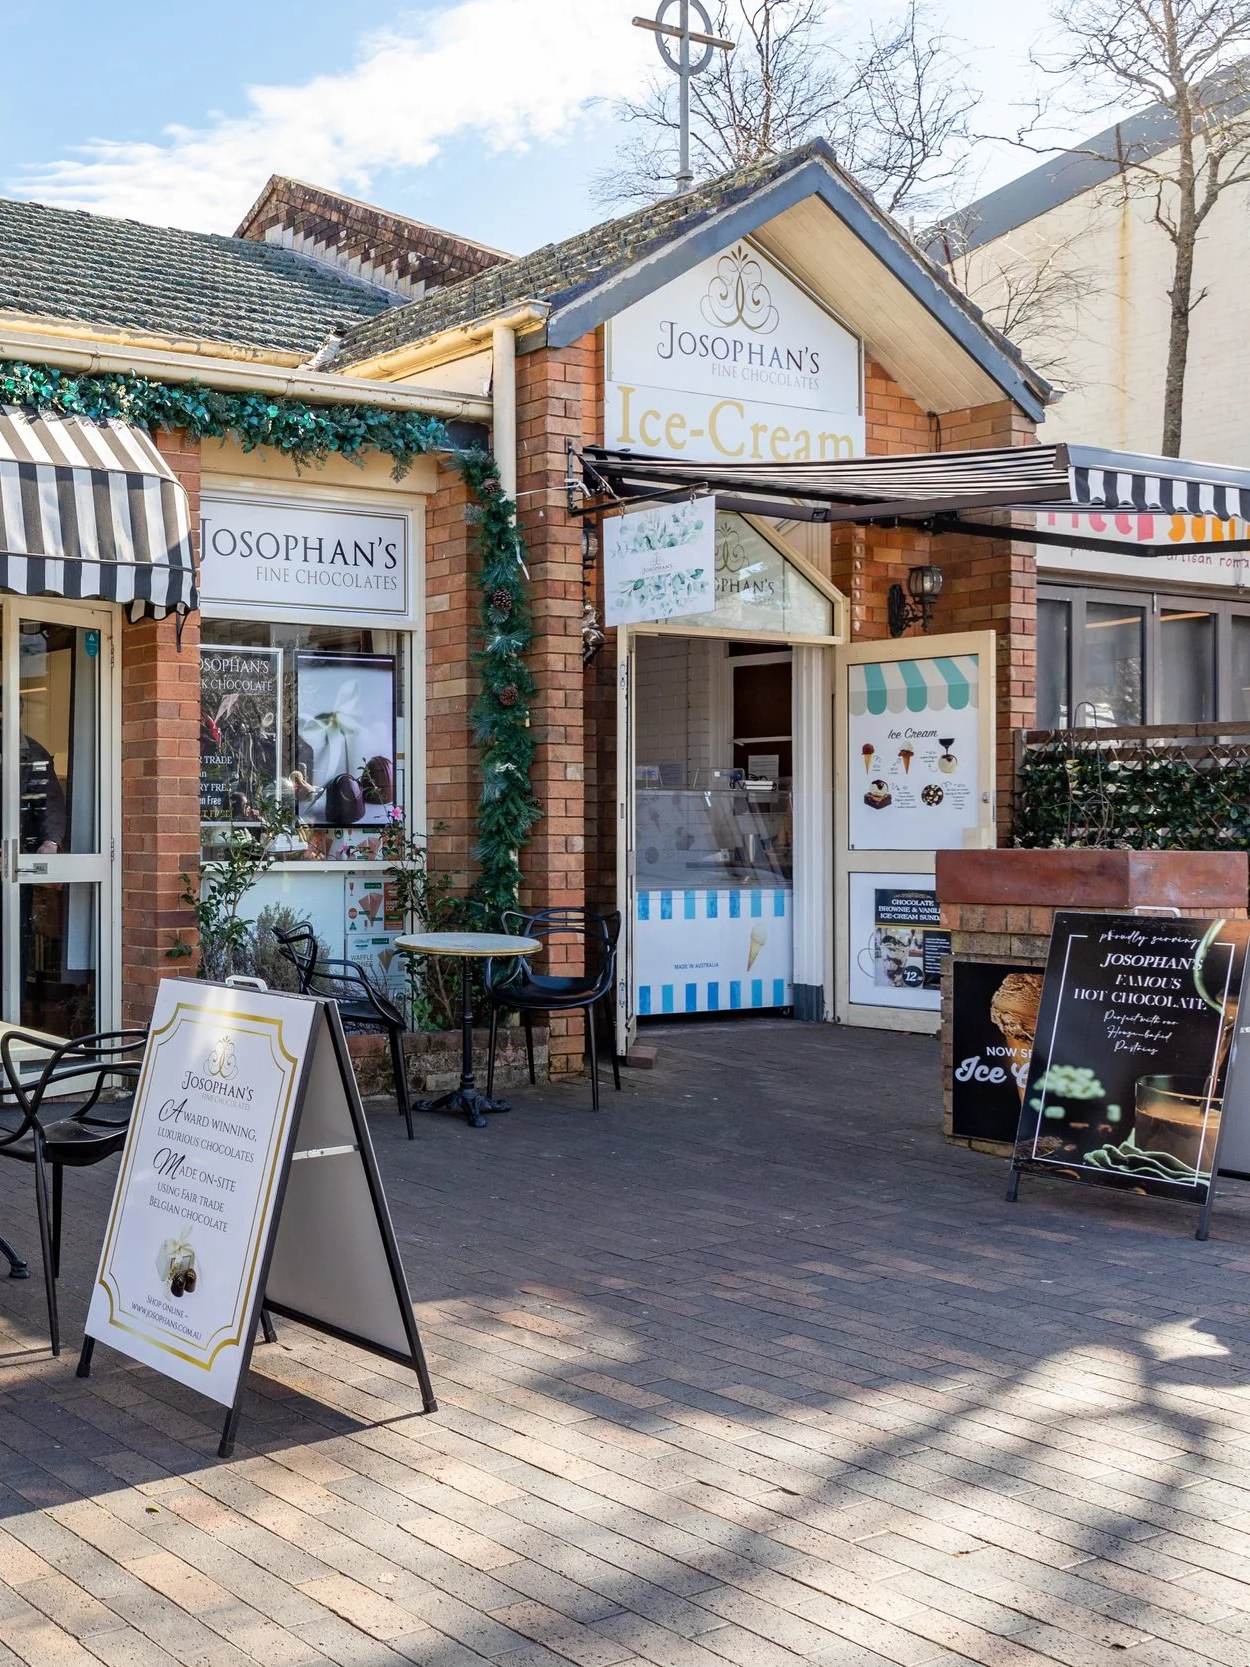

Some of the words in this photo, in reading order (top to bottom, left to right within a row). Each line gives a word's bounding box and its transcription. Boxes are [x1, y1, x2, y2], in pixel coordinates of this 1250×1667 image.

[657, 320, 819, 375] JOSOPHAN'S
[711, 362, 738, 380] FINE
[741, 367, 819, 391] CHOCOLATES
[617, 386, 854, 460] Ice-Cream
[200, 518, 398, 570] JOSOPHAN'S
[256, 566, 290, 583] FINE
[295, 569, 398, 591] CHOCOLATES
[210, 679, 273, 691] CHOCOLATE
[887, 728, 902, 740] Ice
[904, 727, 938, 739] Cream
[204, 755, 233, 765] TRADE
[207, 795, 222, 805] Free
[891, 899, 935, 907] CHOCOLATE
[1100, 953, 1204, 970] JOSOPHAN'S
[1115, 974, 1182, 990] FAMOUS
[1074, 988, 1108, 1001] HOT
[1111, 991, 1207, 1010] CHOCOLATE
[986, 1046, 1017, 1057] NOW
[955, 1055, 1007, 1084] Ice
[181, 1070, 254, 1102] JOSOPHAN'S
[201, 1092, 215, 1102] FINE
[214, 1095, 252, 1112] CHOCOLATES
[158, 1098, 210, 1128] AWARD
[211, 1120, 257, 1142] WINNING,
[157, 1126, 200, 1147] LUXURIOUS
[200, 1139, 255, 1163] CHOCOLATES
[152, 1147, 199, 1180] MADE
[199, 1171, 237, 1193] ON-SITE
[157, 1181, 180, 1198] USING
[181, 1186, 198, 1203] FAIR
[199, 1195, 225, 1212] TRADE
[149, 1195, 180, 1215] BELGIAN
[180, 1207, 229, 1232] CHOCOLATE
[147, 1294, 163, 1308] SHOP
[162, 1303, 185, 1319] ONLINE
[131, 1301, 202, 1341] WWW.JOSOPHANS.COM.AU
